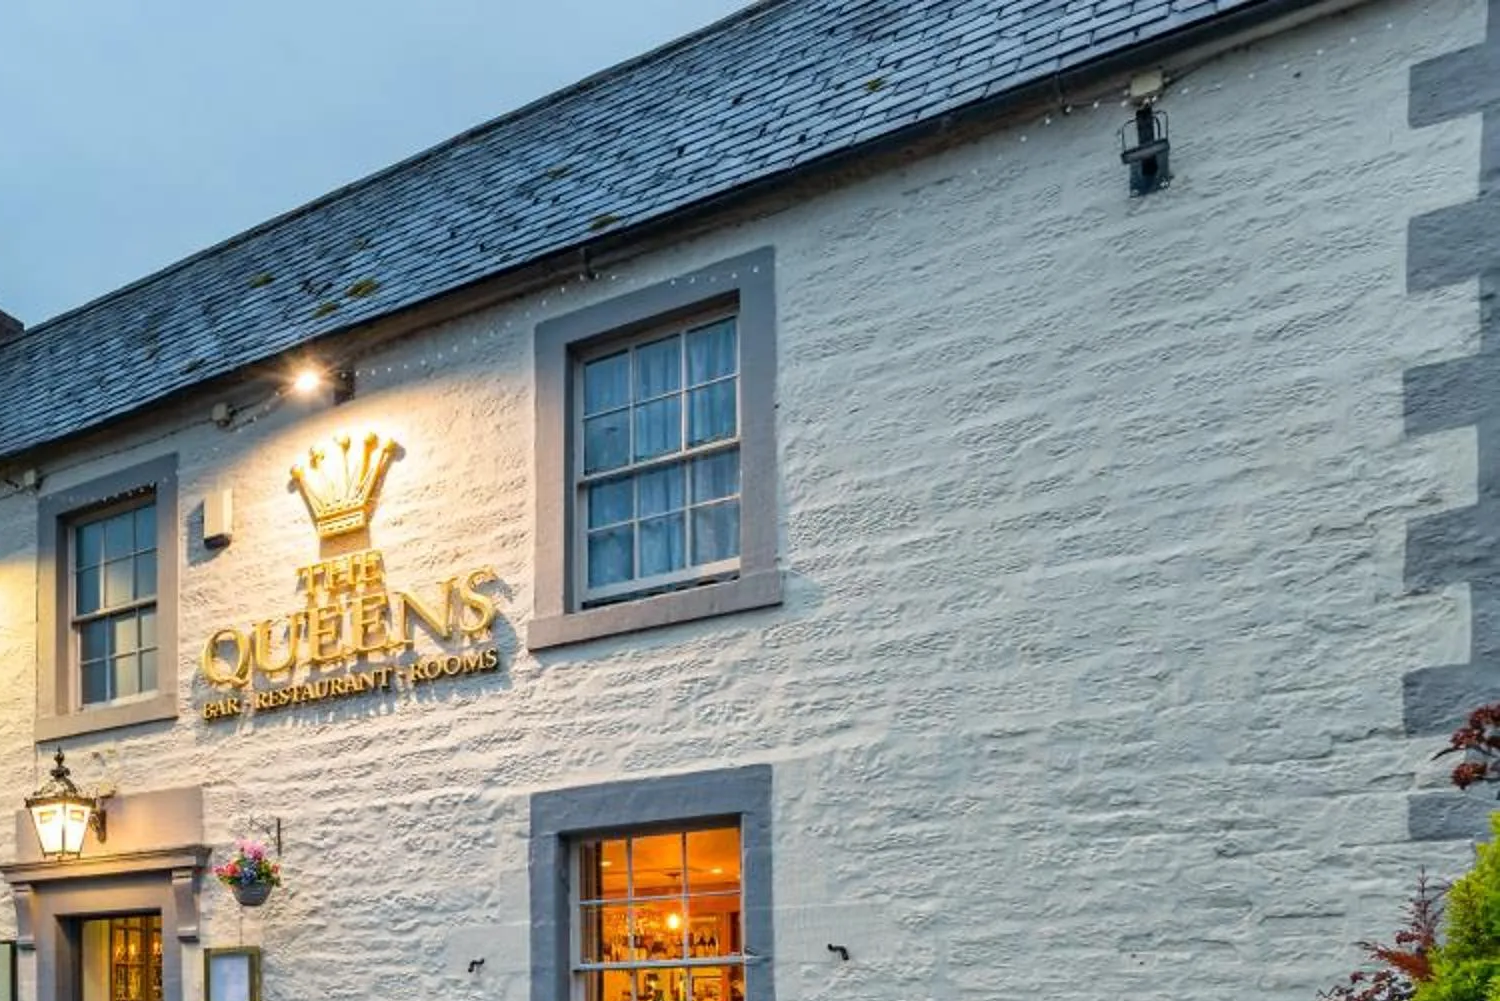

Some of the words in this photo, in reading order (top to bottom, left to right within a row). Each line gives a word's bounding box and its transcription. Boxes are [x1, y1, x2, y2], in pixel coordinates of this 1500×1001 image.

[296, 550, 385, 597] THE
[200, 565, 497, 688] QUEENS
[203, 697, 240, 719] BAR
[255, 665, 393, 710] RESTAURANT
[412, 648, 499, 682] ROOMS
